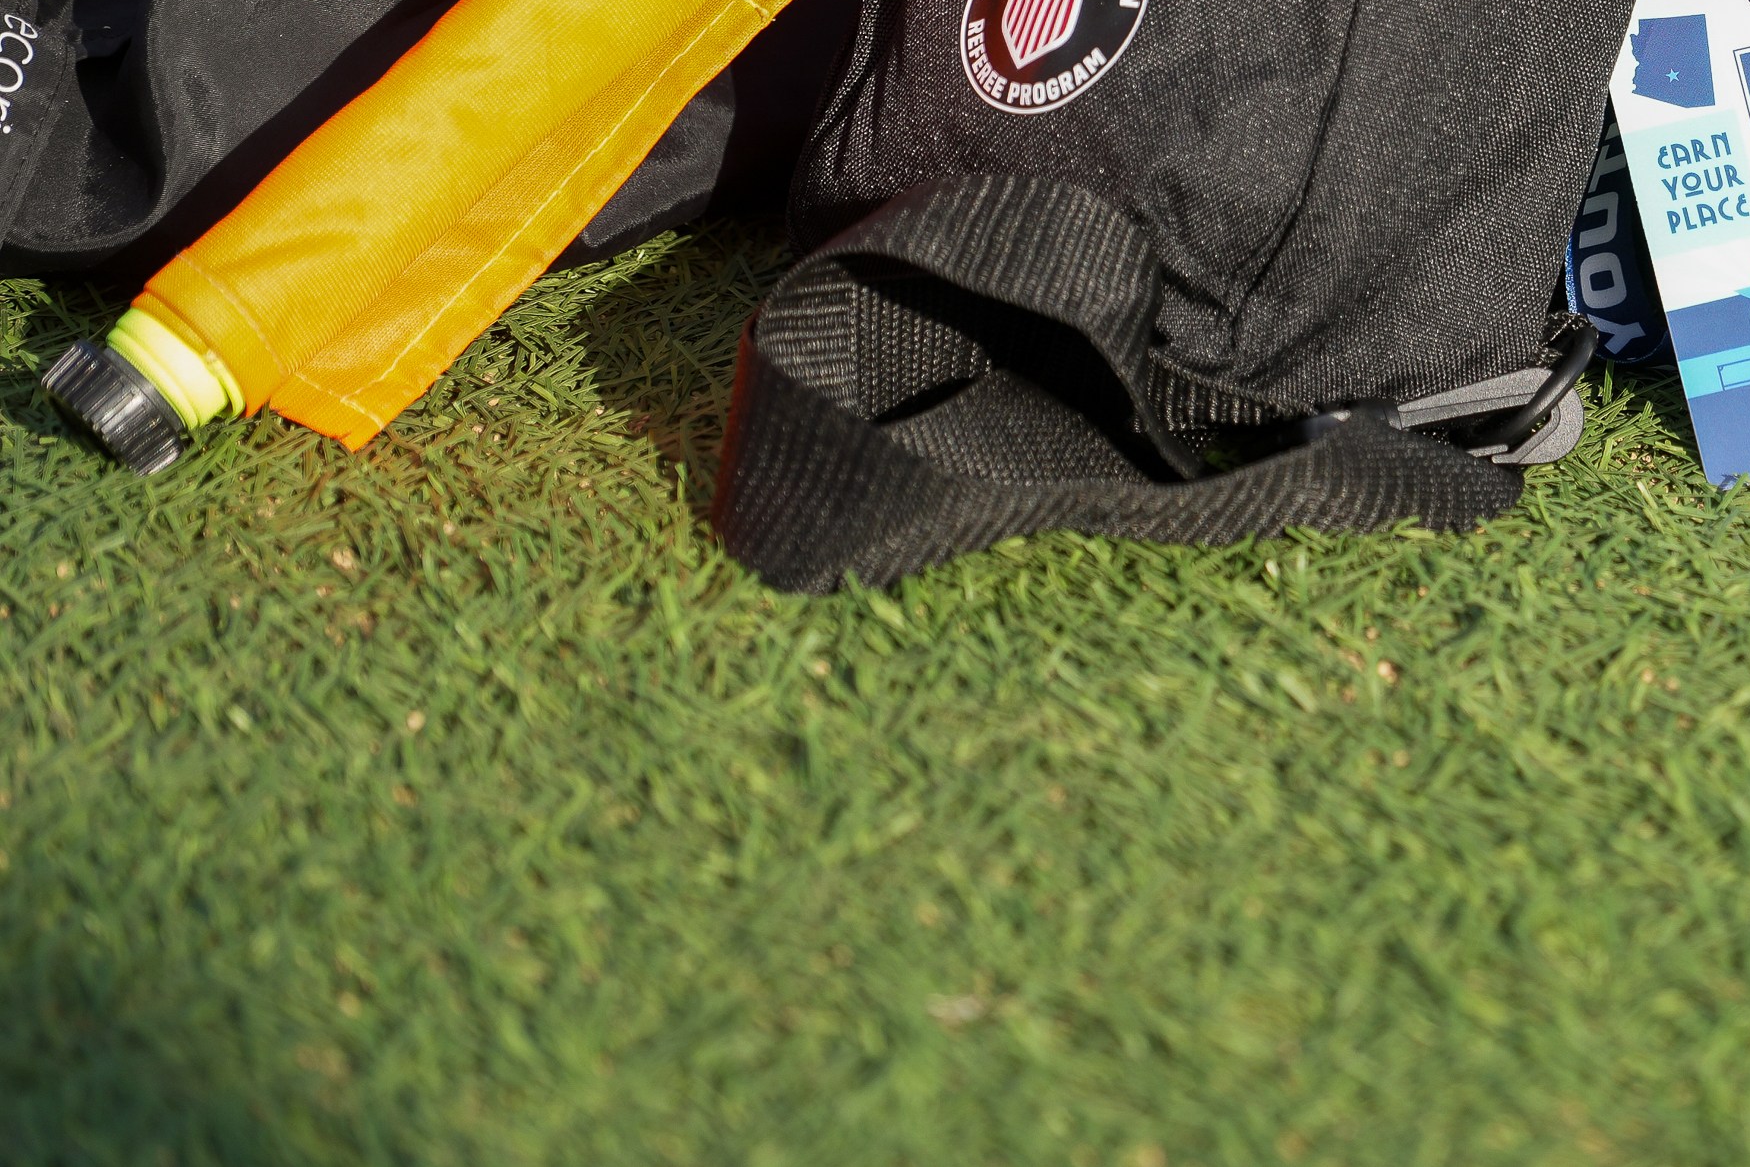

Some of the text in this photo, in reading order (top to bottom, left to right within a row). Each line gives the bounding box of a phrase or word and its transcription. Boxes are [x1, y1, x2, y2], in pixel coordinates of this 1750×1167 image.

[968, 18, 1107, 106] REFEREE PROGRAM
[1657, 132, 1732, 169] EARN
[1661, 164, 1745, 201] YOUR
[1666, 193, 1750, 234] PLACE
